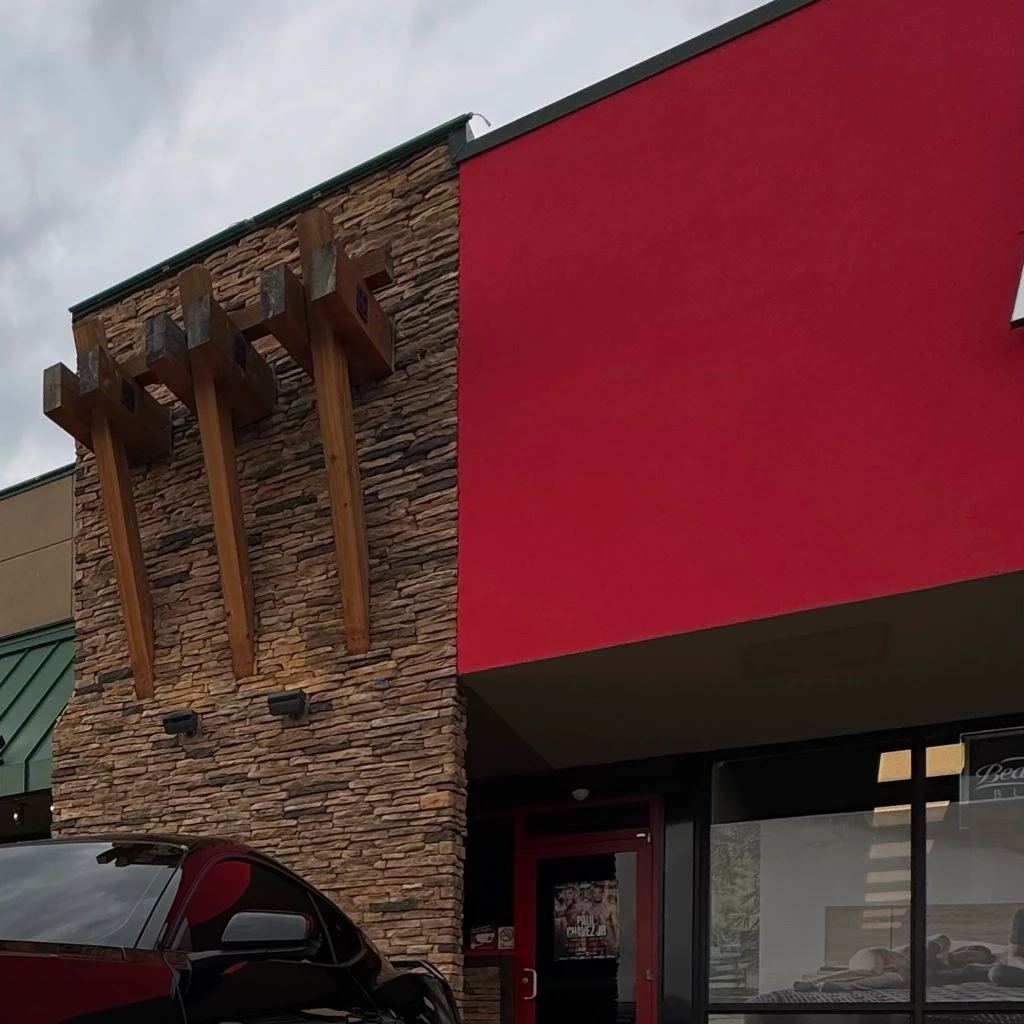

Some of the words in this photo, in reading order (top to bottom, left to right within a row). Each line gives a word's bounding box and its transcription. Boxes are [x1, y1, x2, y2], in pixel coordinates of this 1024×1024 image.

[576, 915, 596, 926] PAUL
[566, 925, 595, 938] CHAVEZ
[595, 924, 607, 937] JR
